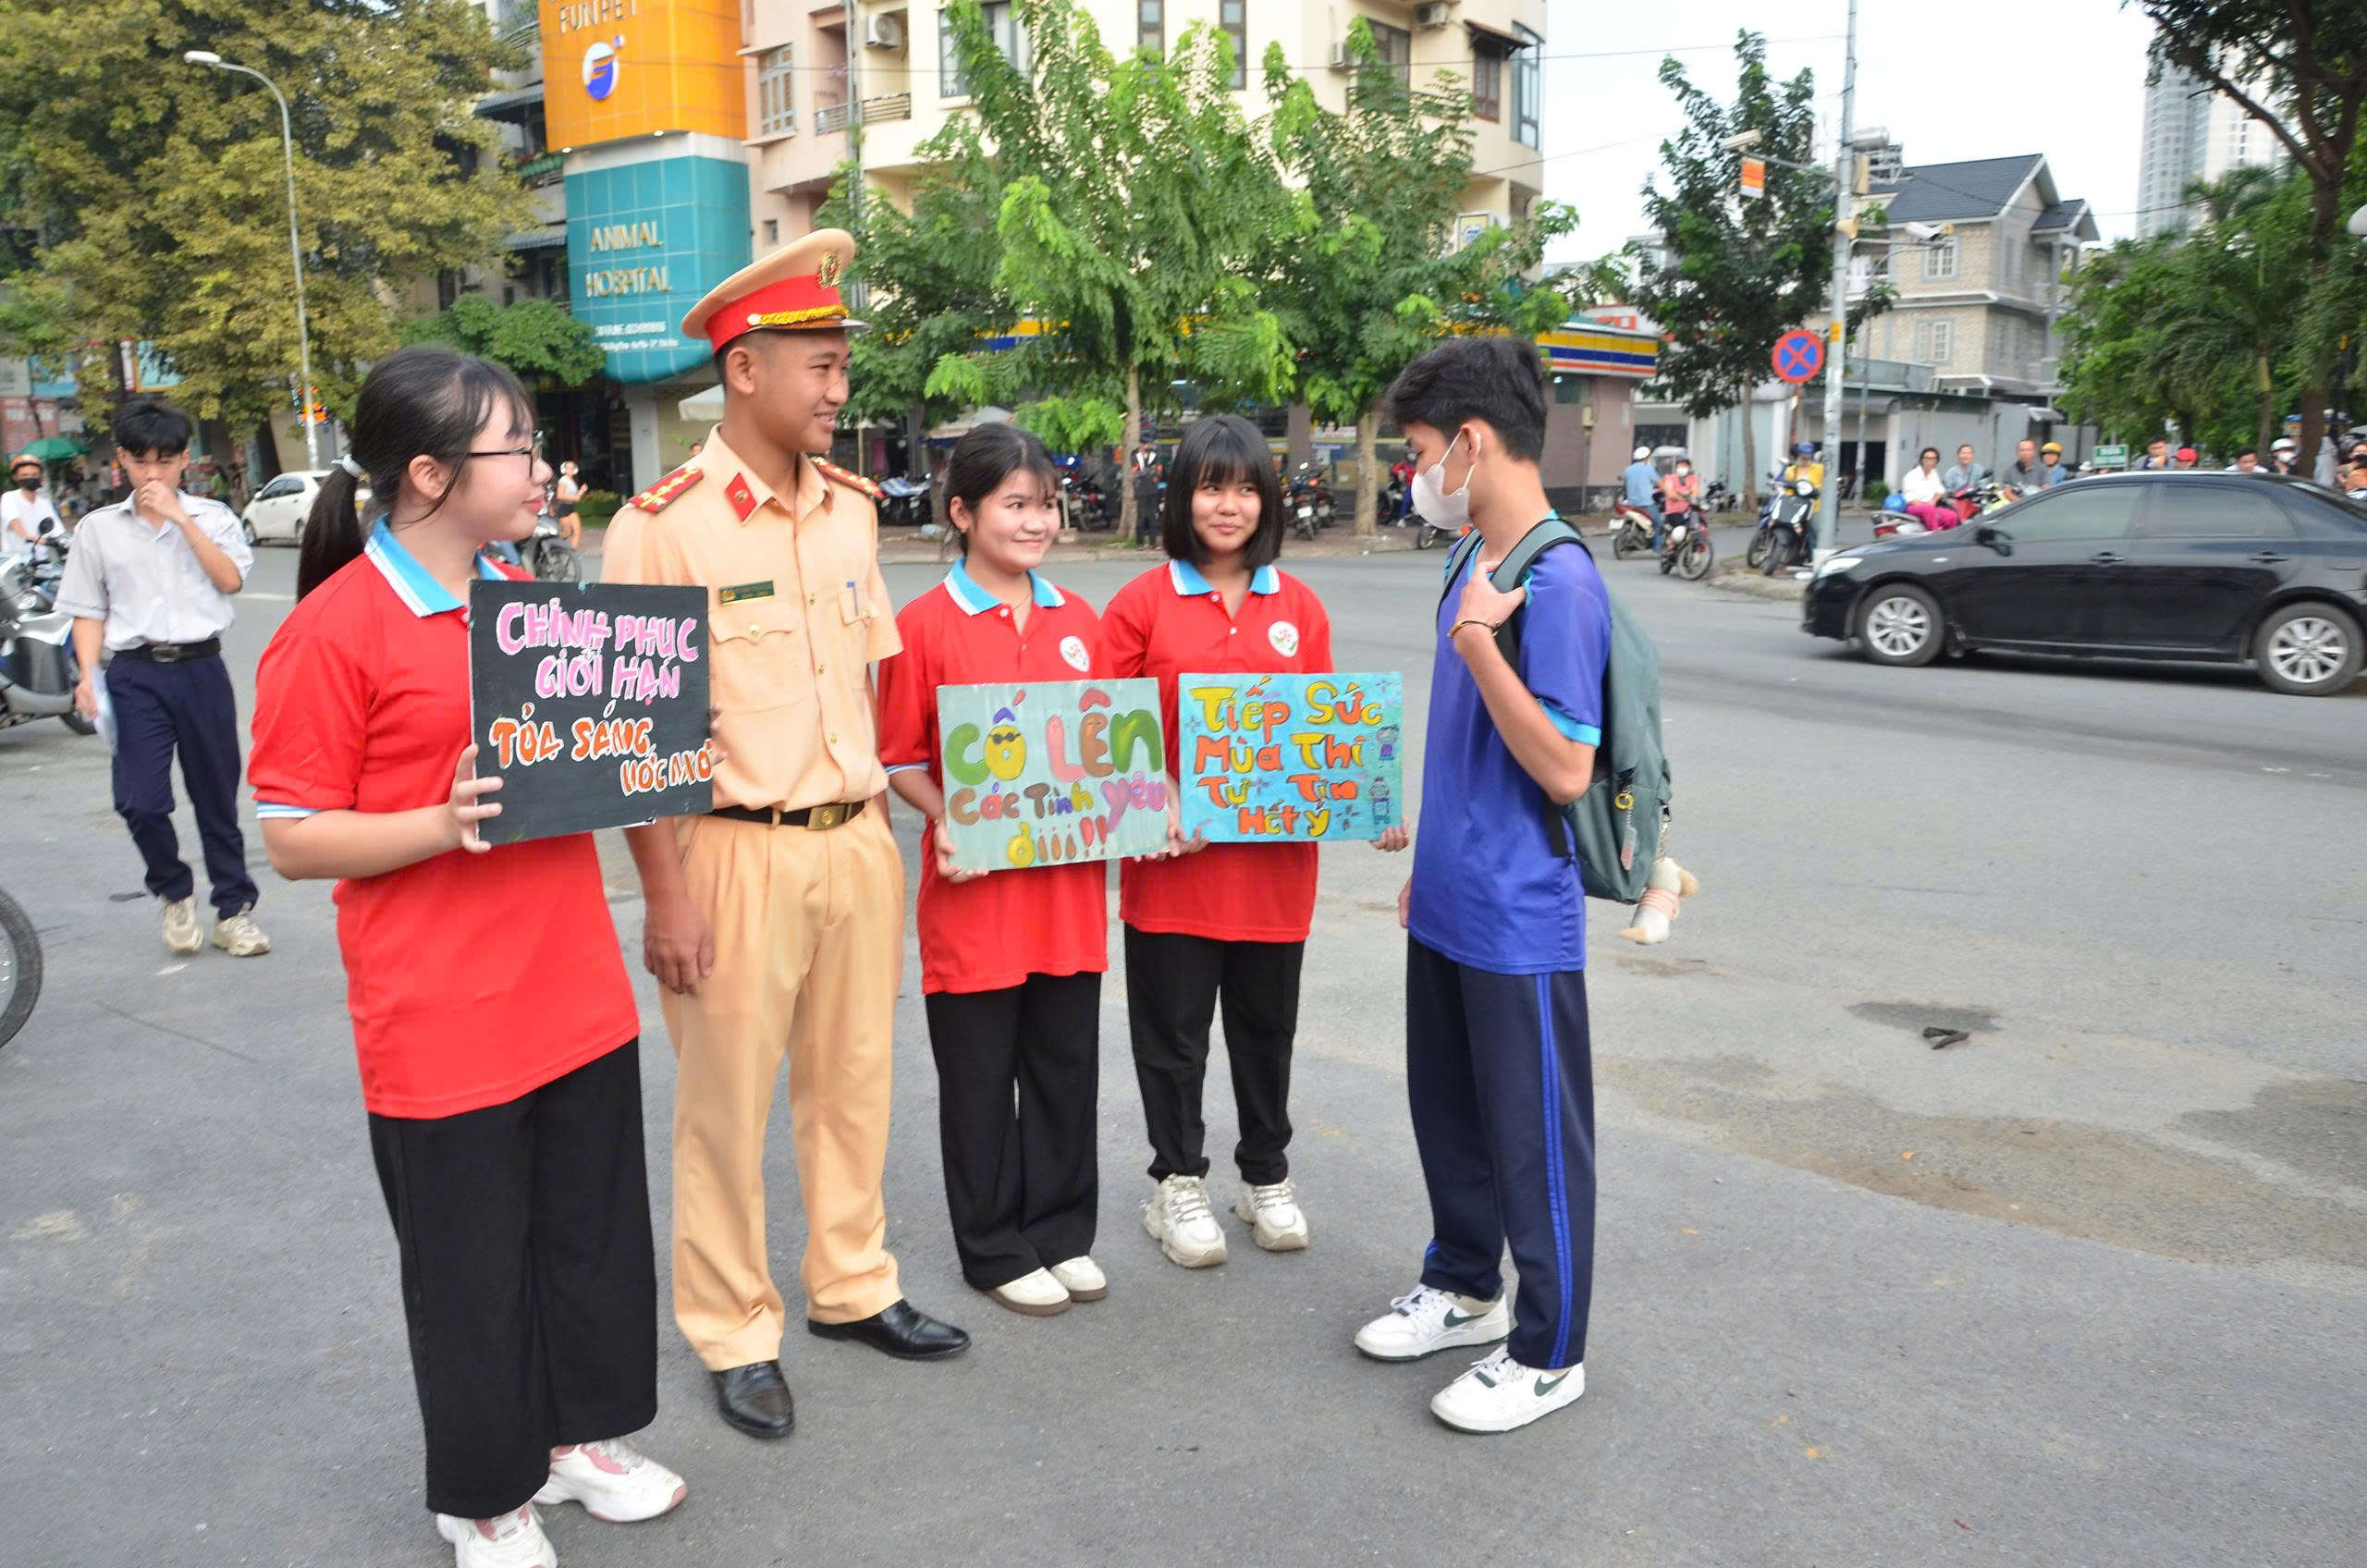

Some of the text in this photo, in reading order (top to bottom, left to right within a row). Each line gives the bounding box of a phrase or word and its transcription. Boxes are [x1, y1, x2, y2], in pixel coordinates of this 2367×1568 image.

[590, 221, 664, 251] ANIMAL
[585, 266, 672, 298] HOSPITAL
[611, 655, 681, 705] HẠN
[1188, 675, 1382, 744] Tiếp Sức
[571, 699, 654, 762] SÁNG
[1194, 732, 1366, 775] Mùa Thi
[1024, 781, 1093, 819] Tình
[1197, 774, 1358, 810] Tự Tin
